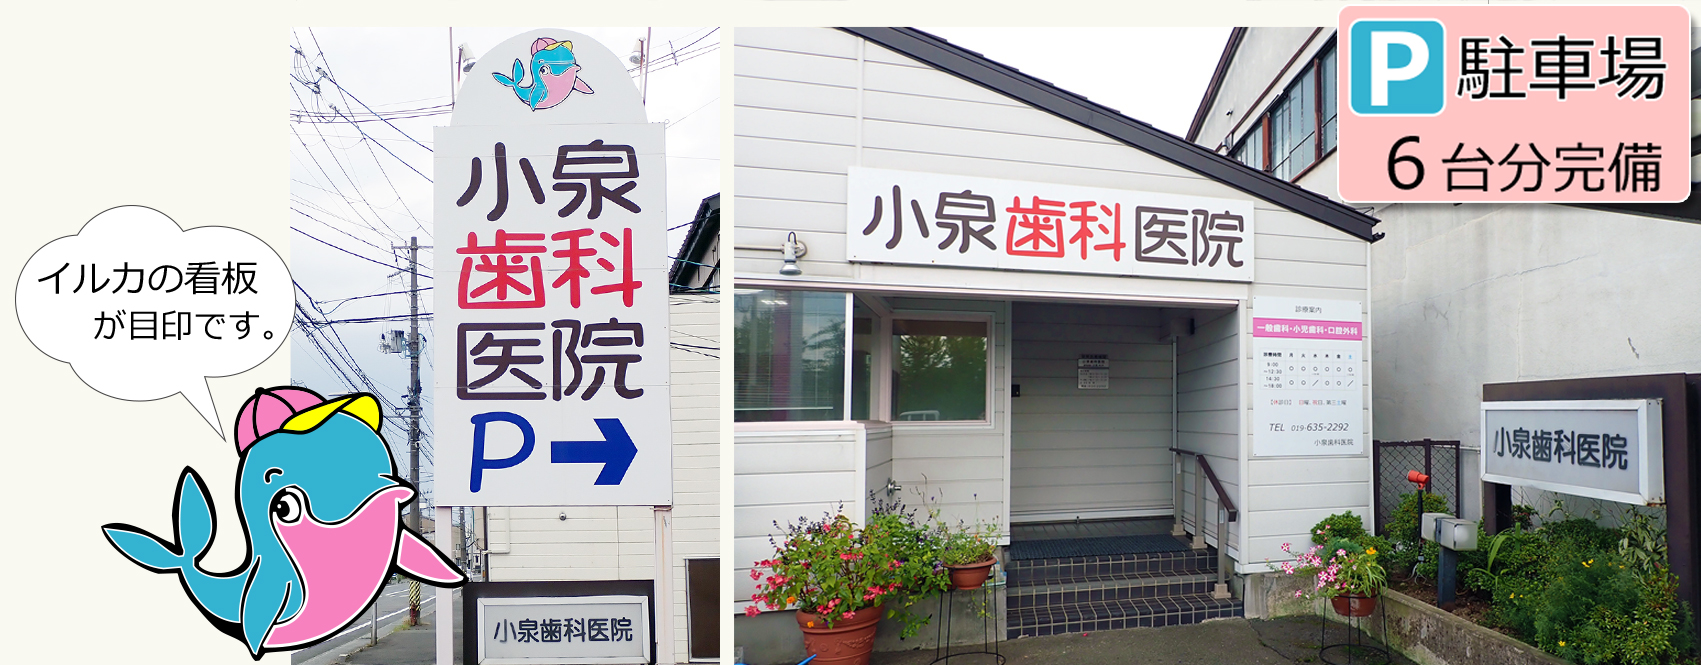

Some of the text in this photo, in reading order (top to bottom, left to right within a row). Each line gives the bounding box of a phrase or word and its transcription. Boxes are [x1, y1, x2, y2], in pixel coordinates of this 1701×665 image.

[457, 139, 642, 221] 小泉
[862, 184, 1245, 268] 小泉歯科医院
[457, 227, 643, 310] 歯科
[1295, 305, 1322, 314] 診療案内
[457, 318, 644, 401] 医院
[470, 411, 535, 493] P
[1269, 423, 1285, 432] TEL
[1493, 426, 1628, 470] 小泉歯科医院
[494, 617, 634, 644] 小泉歯科医院
